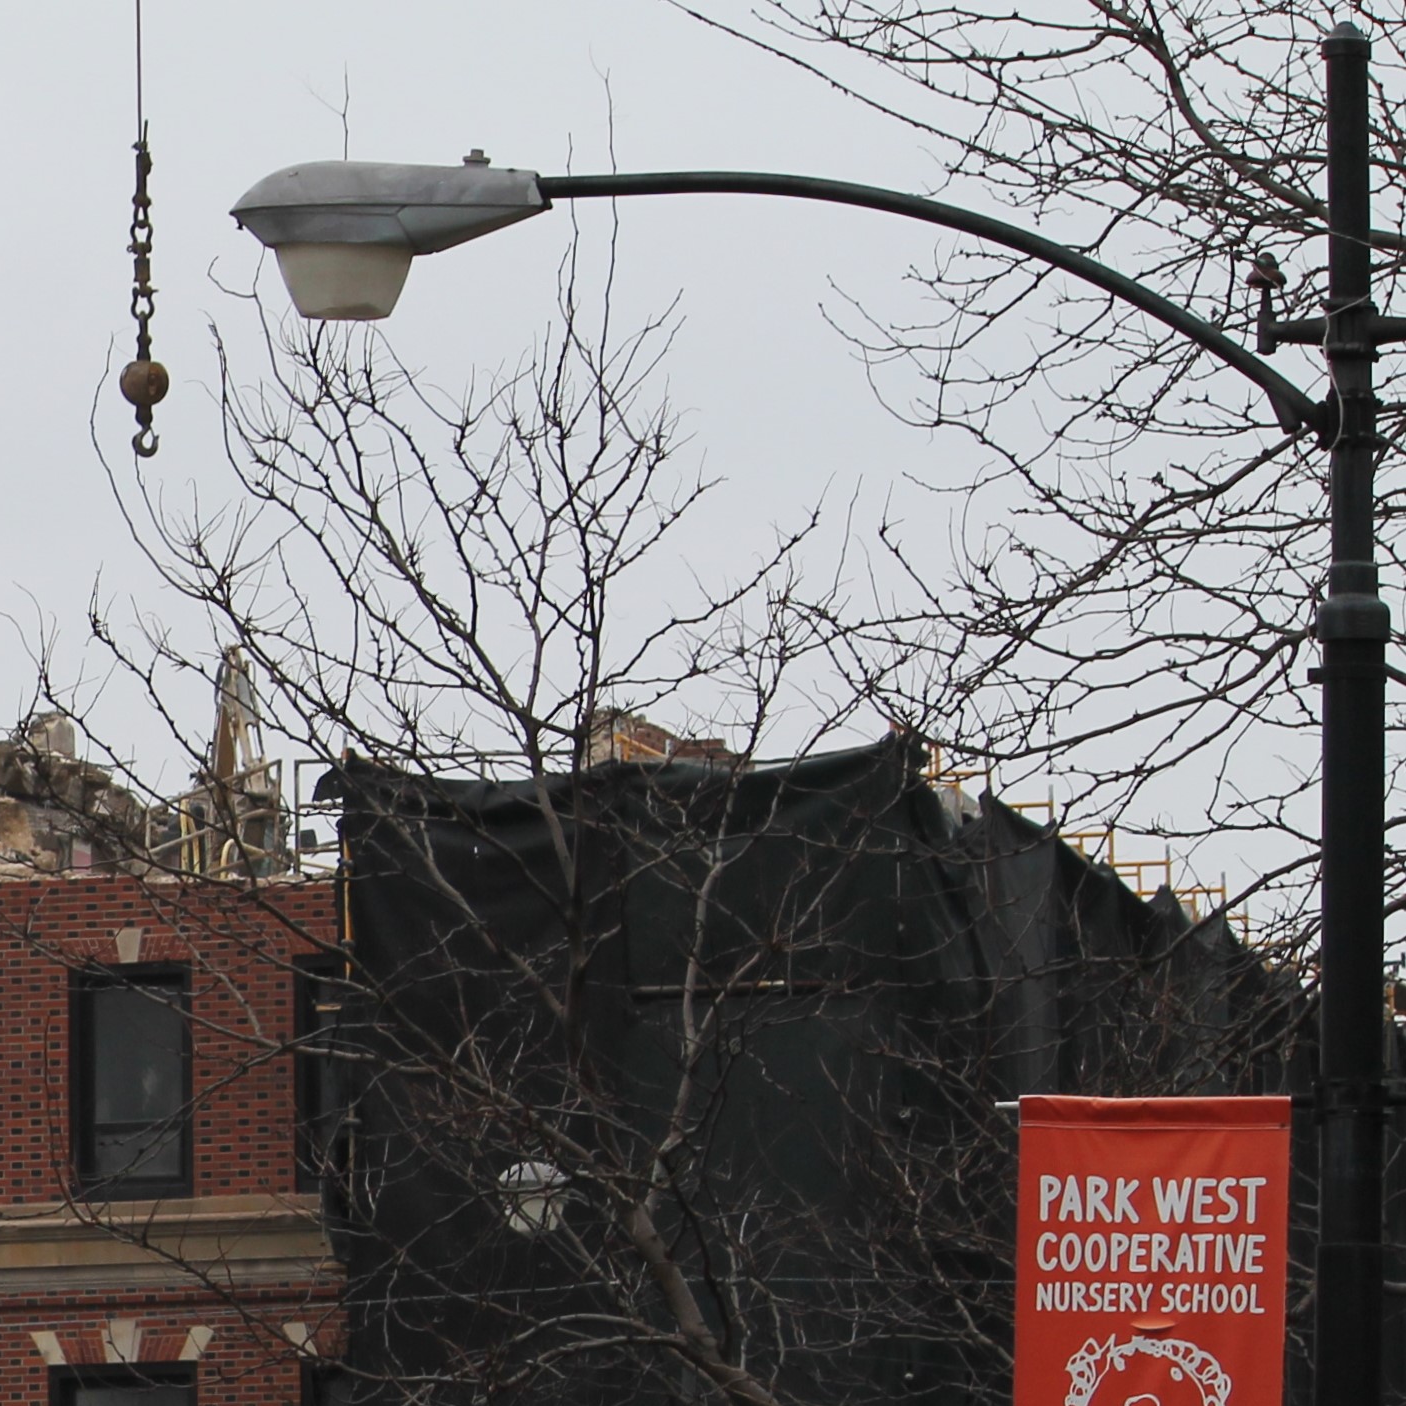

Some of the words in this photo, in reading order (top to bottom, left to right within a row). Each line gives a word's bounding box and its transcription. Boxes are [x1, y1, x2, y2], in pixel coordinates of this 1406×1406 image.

[1039, 1175, 1139, 1223] PARK
[1152, 1177, 1267, 1224] WEST
[1036, 1232, 1266, 1273] COOPERATIVE
[1036, 1281, 1153, 1312] NURSERY
[1161, 1283, 1265, 1313] SCHOOL
